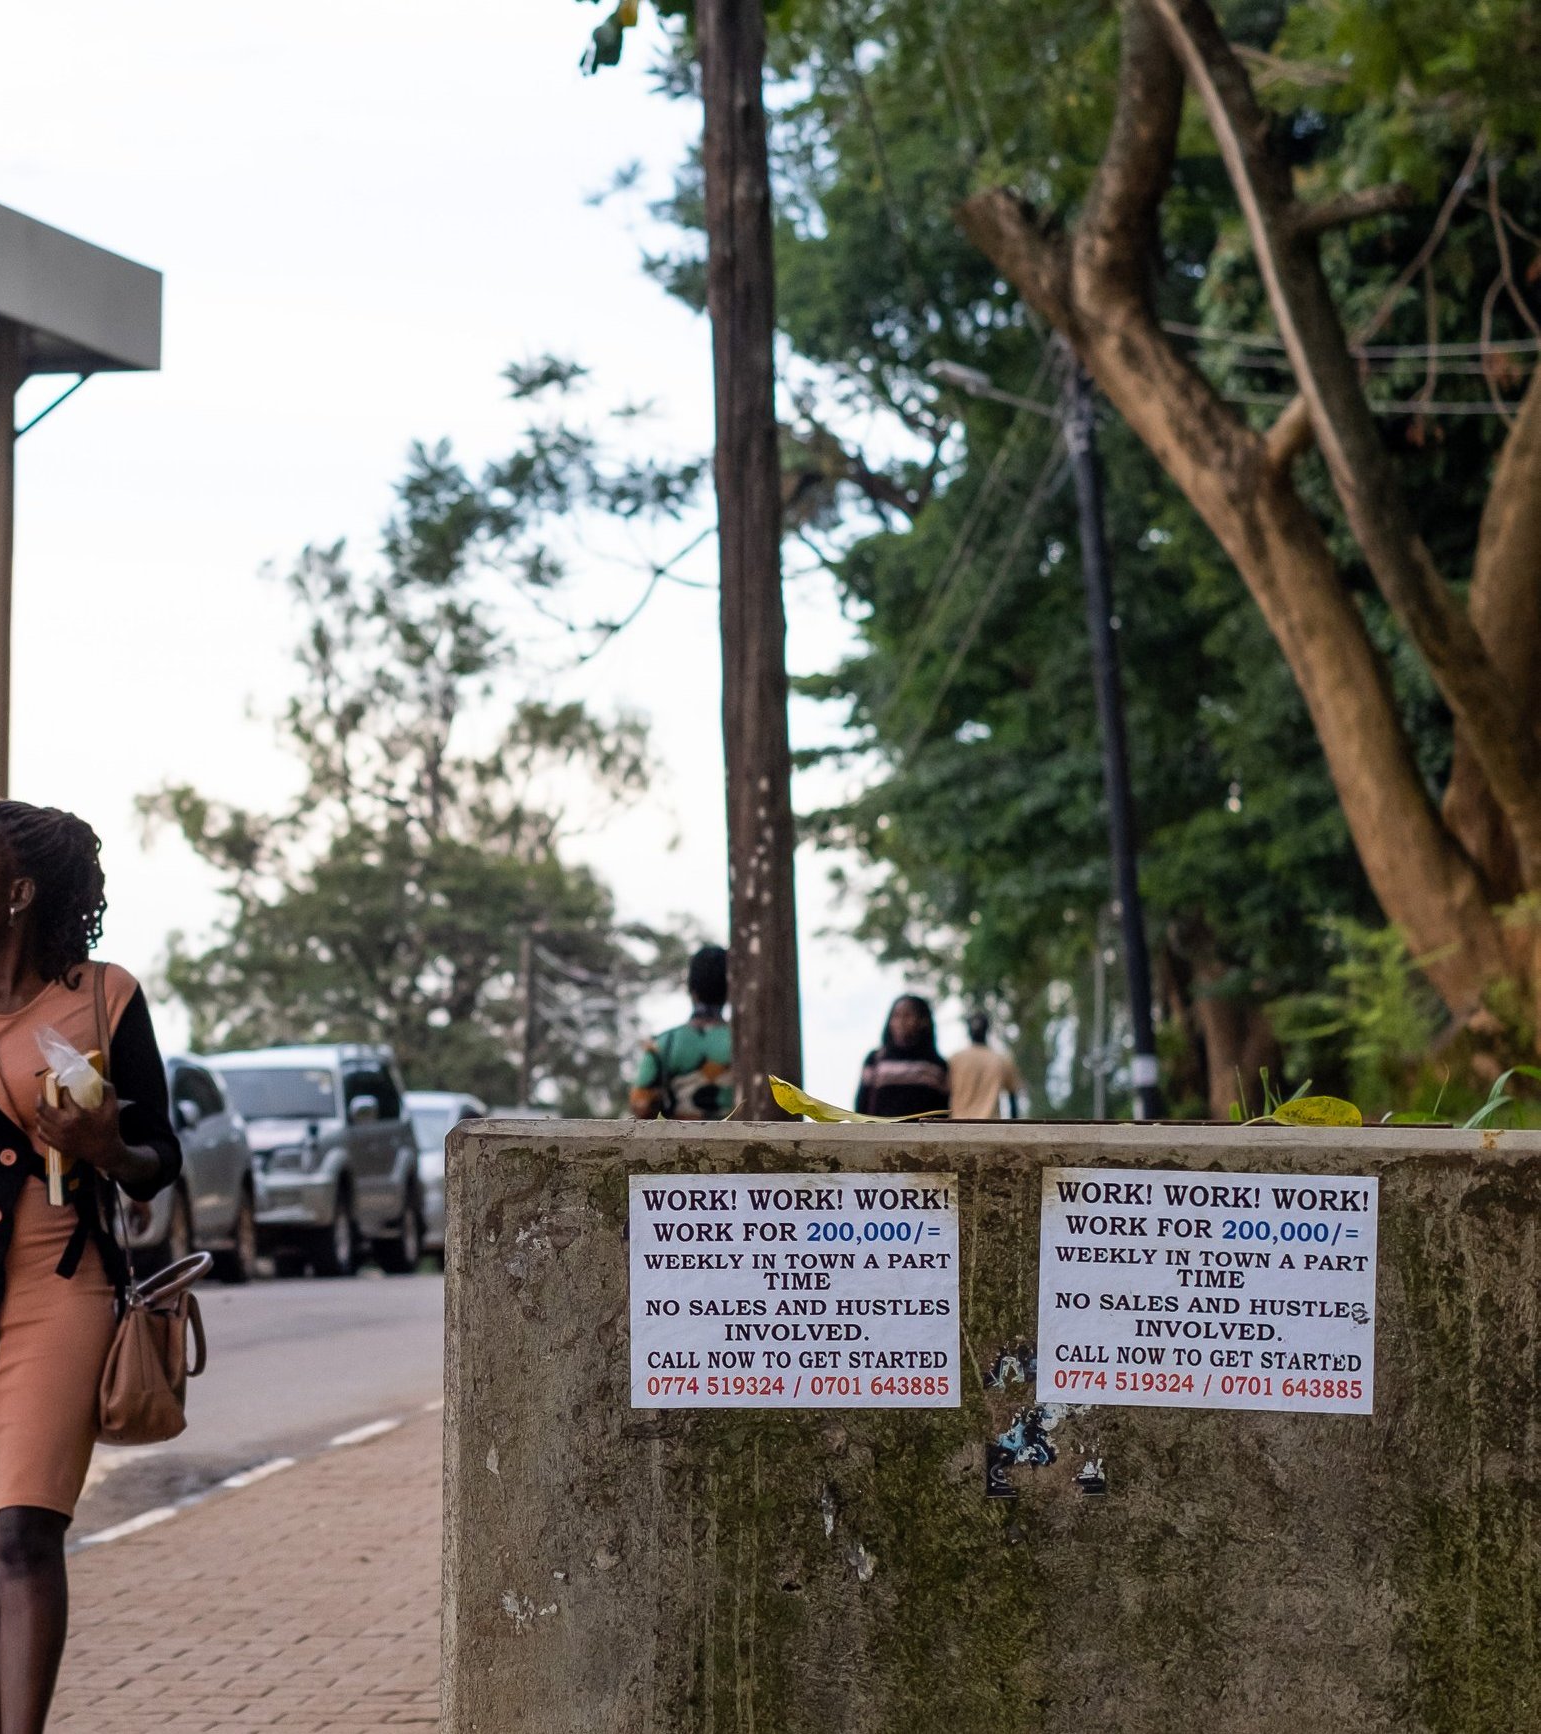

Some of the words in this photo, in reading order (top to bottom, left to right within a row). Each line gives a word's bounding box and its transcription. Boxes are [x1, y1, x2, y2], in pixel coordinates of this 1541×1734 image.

[642, 1189, 737, 1211] WORK!
[748, 1189, 843, 1211] WORK!
[854, 1188, 950, 1210] WORK!
[1057, 1181, 1152, 1205] WORK!
[1164, 1184, 1260, 1209] WORK!
[1271, 1188, 1369, 1212] WORK!
[653, 1223, 733, 1242] WORK
[743, 1223, 797, 1242] FOR
[807, 1222, 940, 1245] 200,000/=
[1066, 1215, 1148, 1236] WORK
[1157, 1218, 1212, 1238] FOR
[1222, 1220, 1358, 1246] 200,000/=
[644, 1254, 744, 1269] WEEKLY
[752, 1254, 776, 1269] IN
[785, 1254, 855, 1269] TOWN
[863, 1253, 879, 1268] A
[888, 1253, 950, 1269] PART
[1055, 1246, 1157, 1264] WEEKLY
[1165, 1250, 1190, 1266] IN
[1199, 1251, 1270, 1268] TOWN
[1278, 1253, 1295, 1269] A
[1304, 1254, 1368, 1271] PART
[764, 1272, 831, 1290] TIME
[1177, 1269, 1245, 1289] TIME
[646, 1300, 680, 1316] NO
[689, 1300, 767, 1316] SALES
[775, 1300, 827, 1315] AND
[835, 1299, 950, 1316] HUSTLES
[1055, 1292, 1090, 1310] NO
[1100, 1294, 1178, 1312] SALES
[1187, 1297, 1240, 1314] AND
[1249, 1299, 1368, 1319] HUSTLES
[725, 1324, 870, 1341] INVOLVED.
[1135, 1320, 1283, 1342] INVOLVED.
[647, 1351, 700, 1369] CALL
[708, 1351, 755, 1369] NOW
[762, 1351, 791, 1369] TO
[798, 1351, 841, 1369] GET
[849, 1351, 948, 1369] STARTED
[1055, 1345, 1109, 1364] CALL
[1117, 1348, 1165, 1365] NOW
[1173, 1349, 1201, 1366] TO
[1210, 1350, 1253, 1368] GET
[1261, 1351, 1361, 1372] STARTED
[647, 1376, 699, 1395] 0774
[707, 1376, 785, 1395] 519324
[793, 1376, 801, 1399] /
[810, 1376, 861, 1395] 0701
[870, 1376, 949, 1395] 643885
[1055, 1370, 1107, 1390] 0774
[1115, 1372, 1194, 1393] 519324
[1203, 1374, 1211, 1396] /
[1221, 1376, 1273, 1396] 0701
[1282, 1378, 1362, 1399] 643885
